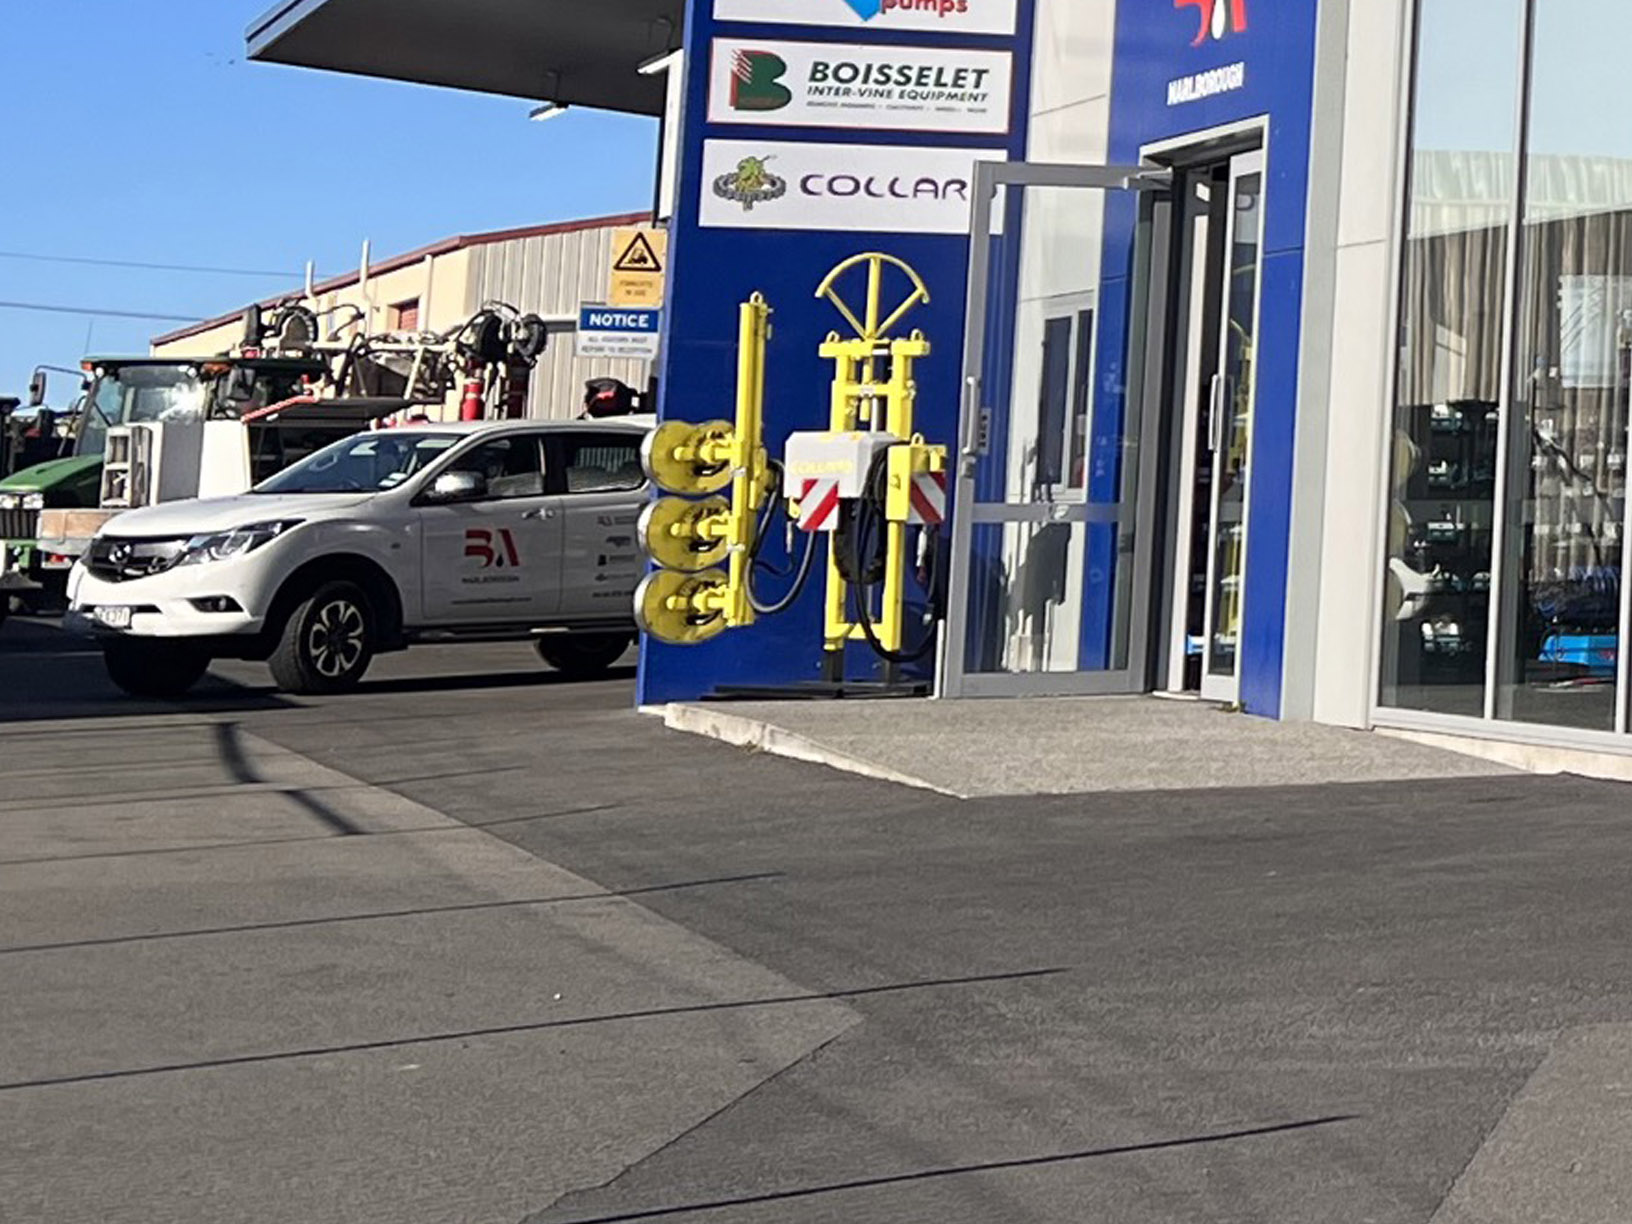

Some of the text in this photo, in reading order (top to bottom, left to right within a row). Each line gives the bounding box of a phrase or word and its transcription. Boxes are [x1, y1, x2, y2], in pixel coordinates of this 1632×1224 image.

[808, 61, 989, 89] BOISSELET
[807, 86, 988, 102] INTER-VINE EQUIPMENT
[800, 174, 997, 201] COLLAR
[589, 313, 649, 328] NOTICE
